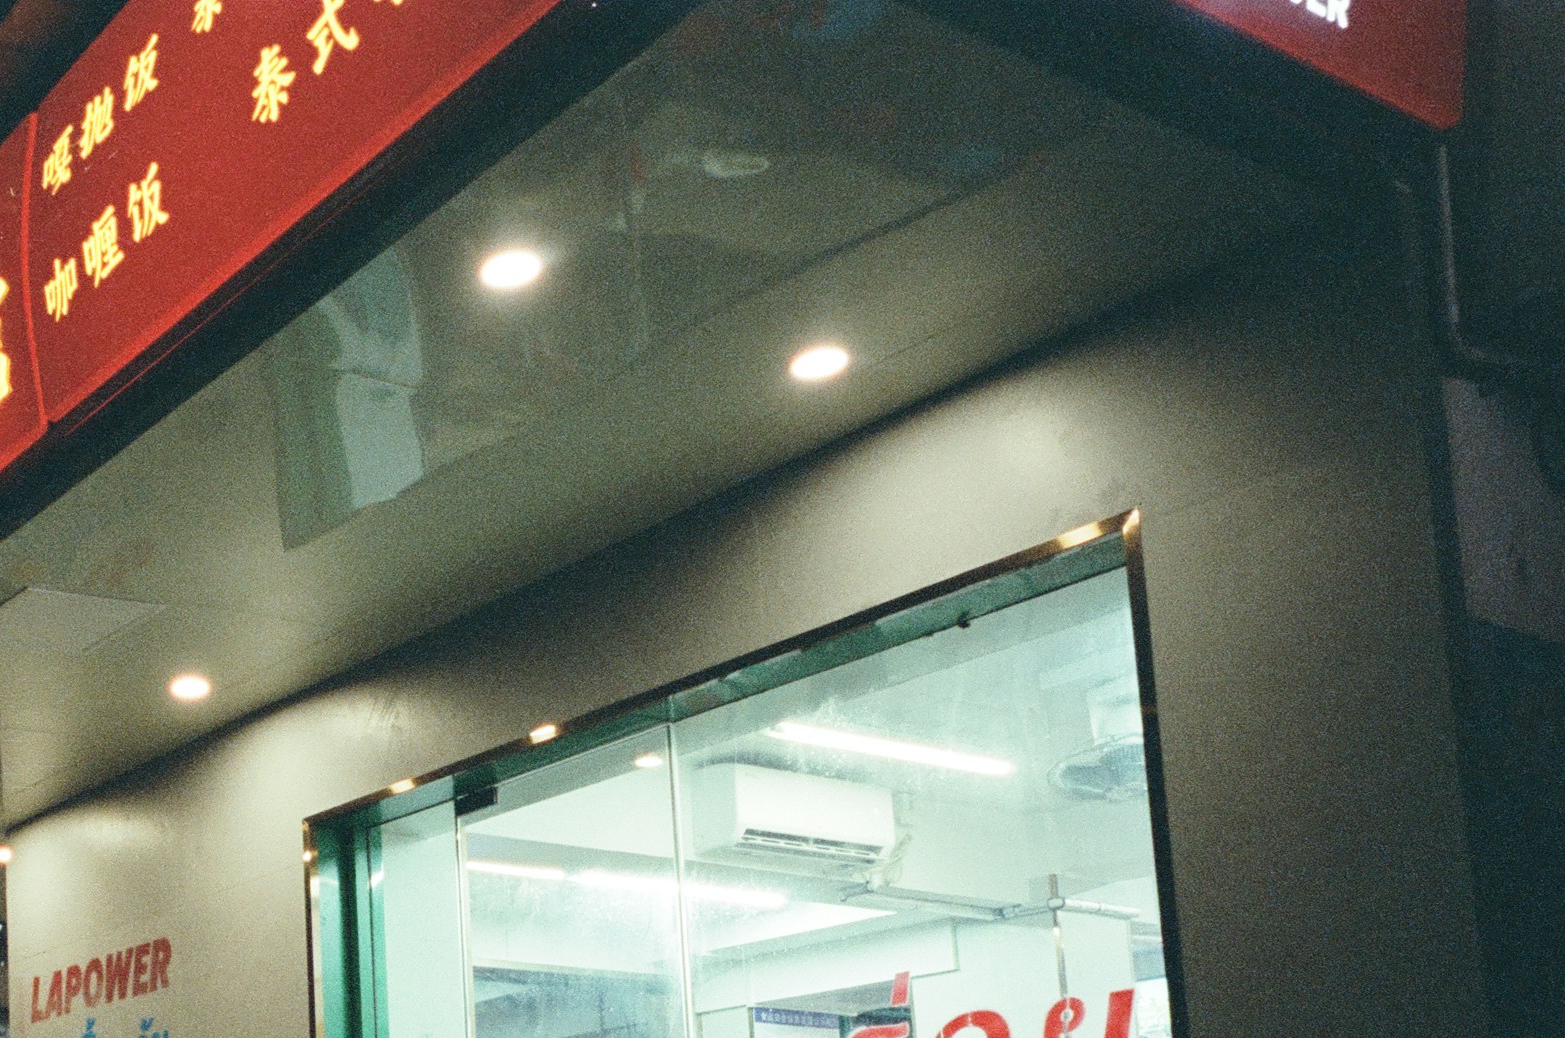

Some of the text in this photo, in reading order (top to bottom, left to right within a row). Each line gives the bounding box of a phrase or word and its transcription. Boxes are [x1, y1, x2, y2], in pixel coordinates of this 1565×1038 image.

[43, 162, 170, 322] 咖喱饭
[31, 936, 172, 1024] LAPOWER
